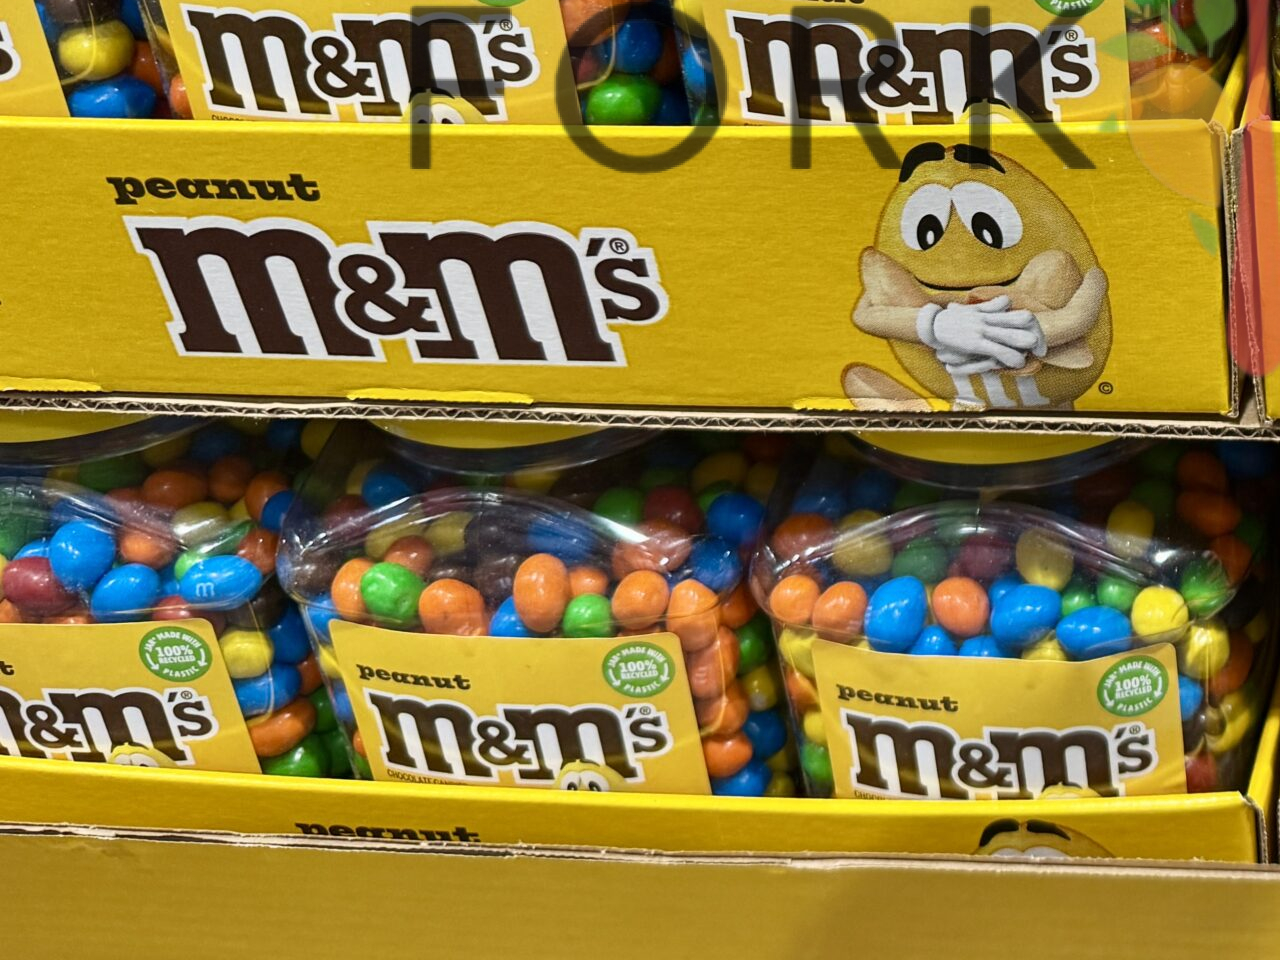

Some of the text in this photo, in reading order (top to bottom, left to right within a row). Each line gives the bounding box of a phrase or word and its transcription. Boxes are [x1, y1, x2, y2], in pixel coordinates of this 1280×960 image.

[188, 9, 533, 117] m&m's
[732, 14, 1091, 124] m&m's
[107, 174, 321, 205] peanut
[135, 227, 660, 362] m&m's
[196, 581, 215, 597] m
[156, 631, 182, 641] MADE
[156, 645, 194, 658] 100%
[158, 654, 196, 665] RECYCLED
[621, 647, 647, 657] MADE
[163, 666, 200, 678] PLASTIC
[619, 659, 657, 673] 100%
[1118, 661, 1143, 673] MADE
[357, 664, 470, 690] peanut
[620, 669, 658, 681] RECYCLED
[1114, 674, 1152, 691] 100%
[624, 680, 661, 694] PLASTIC
[1115, 685, 1153, 699] RECYCLED
[838, 685, 958, 713] peanut
[1117, 696, 1153, 712] PLASTIC
[0, 690, 212, 763] &m's
[369, 692, 667, 782] m&m's
[845, 713, 1152, 799] m&m's
